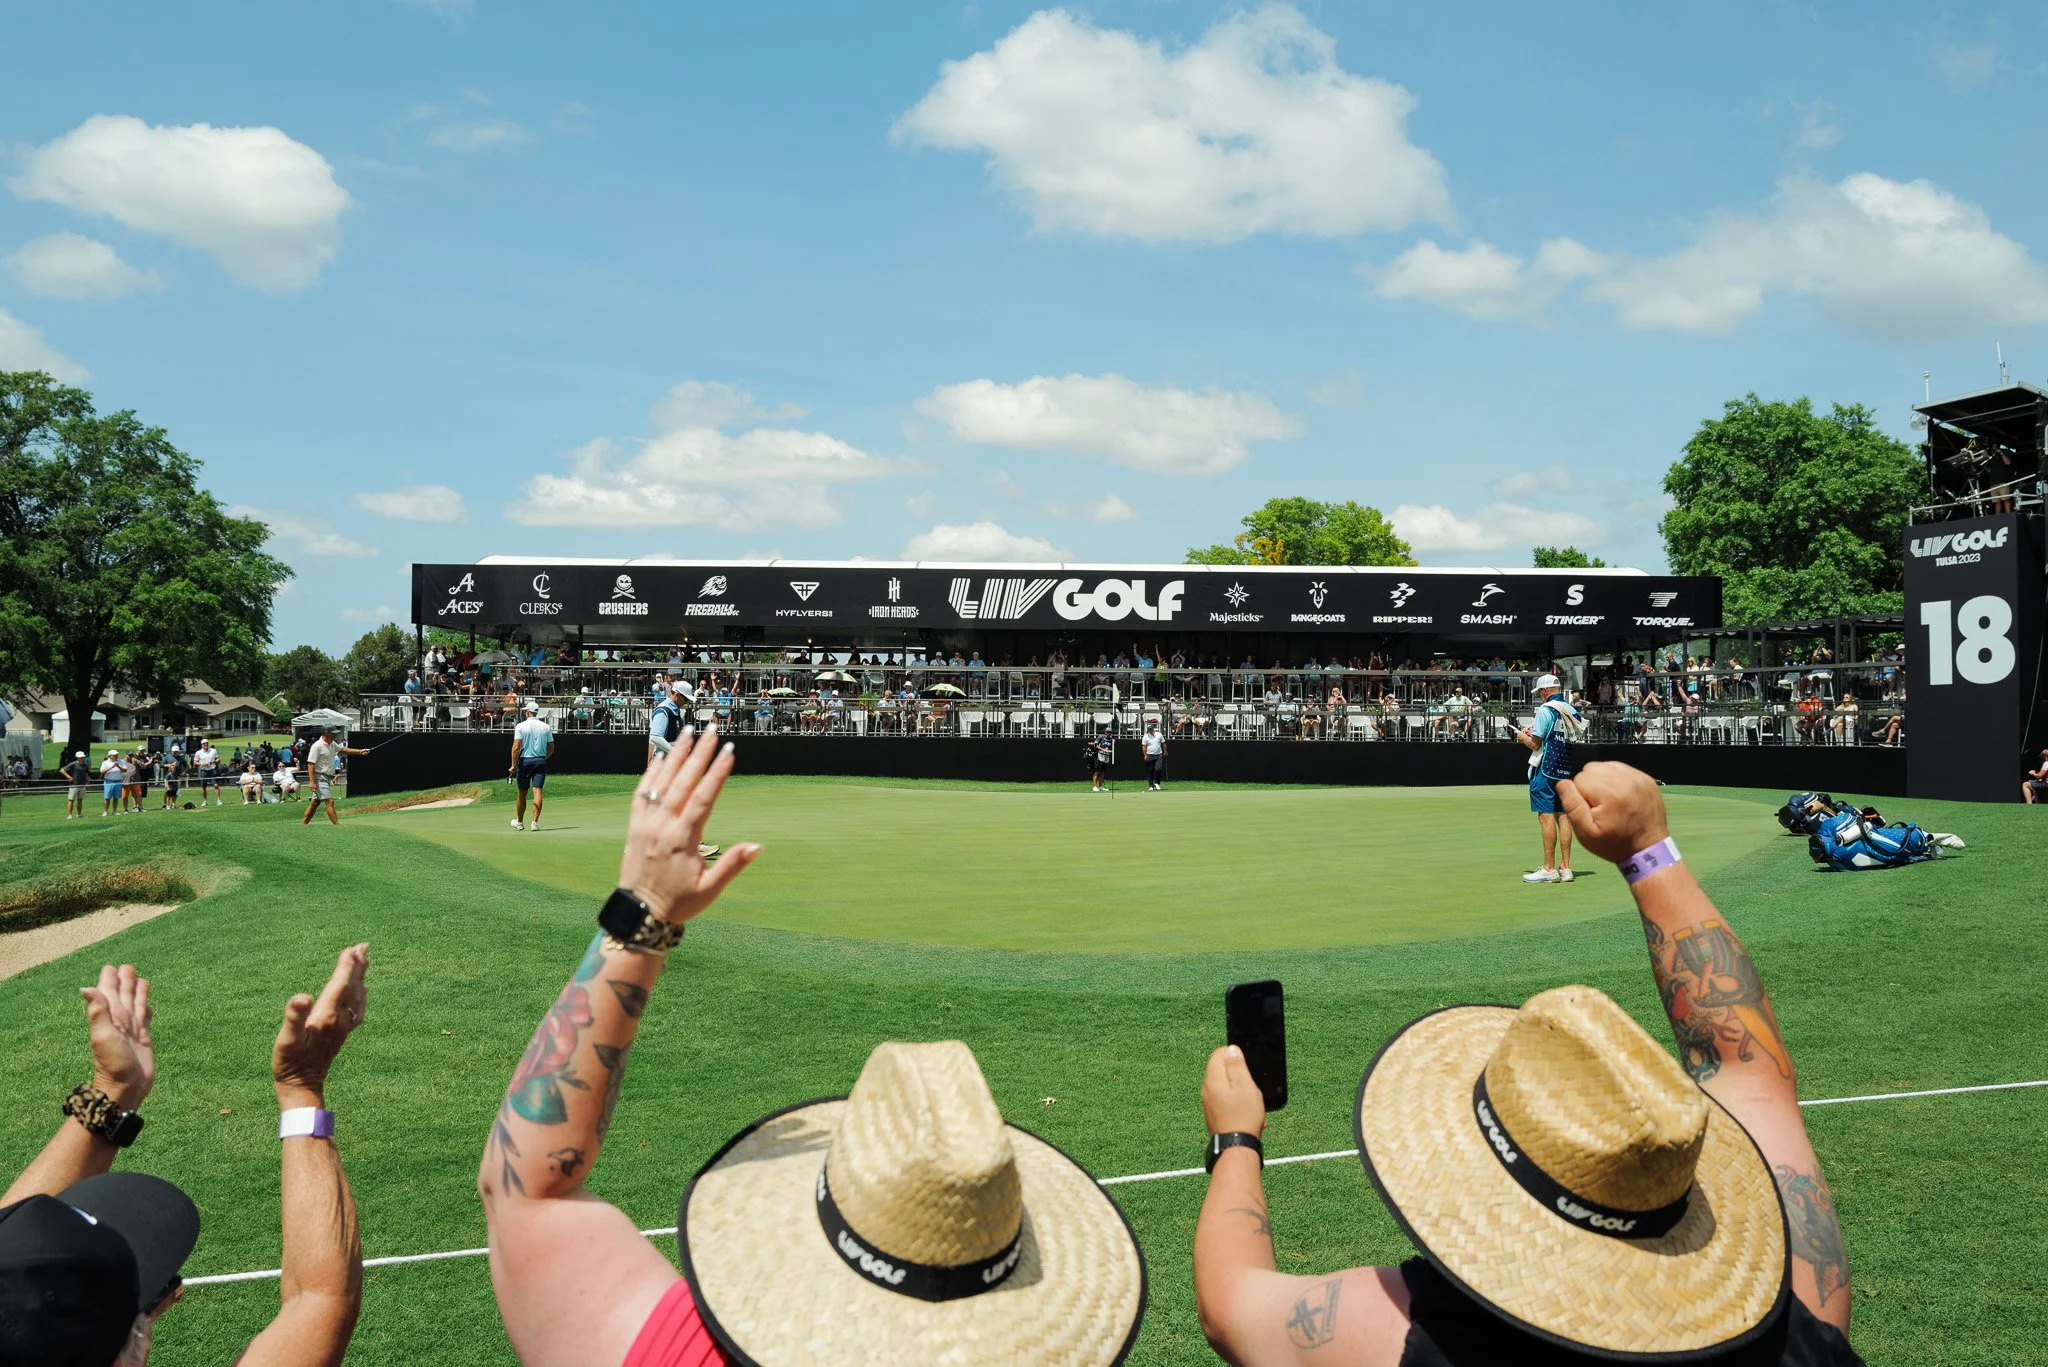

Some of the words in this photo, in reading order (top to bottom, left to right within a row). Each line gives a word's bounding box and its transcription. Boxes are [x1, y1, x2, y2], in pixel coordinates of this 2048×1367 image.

[1909, 534, 1955, 558] LIV
[1951, 526, 2009, 553] GOLF
[1935, 556, 1957, 567] TULSA
[1958, 552, 1981, 564] 2023
[948, 578, 1059, 619] LIV
[1052, 578, 1185, 621] GOLF
[598, 602, 649, 615] CRUSHERS
[684, 603, 734, 616] FIREBALLS
[775, 609, 829, 617] HYFLYERS
[871, 606, 890, 618] IRON
[891, 606, 917, 618] HEADS
[1209, 612, 1260, 624] Majesticks
[1290, 614, 1346, 622] RANGEGOATS
[1460, 614, 1513, 624] SMASH
[1545, 615, 1599, 625] STINGER
[1632, 616, 1690, 628] TORQUE
[1920, 595, 2016, 686] 18
[1589, 1213, 1637, 1232] GOLF
[859, 1252, 907, 1285] GOLF
